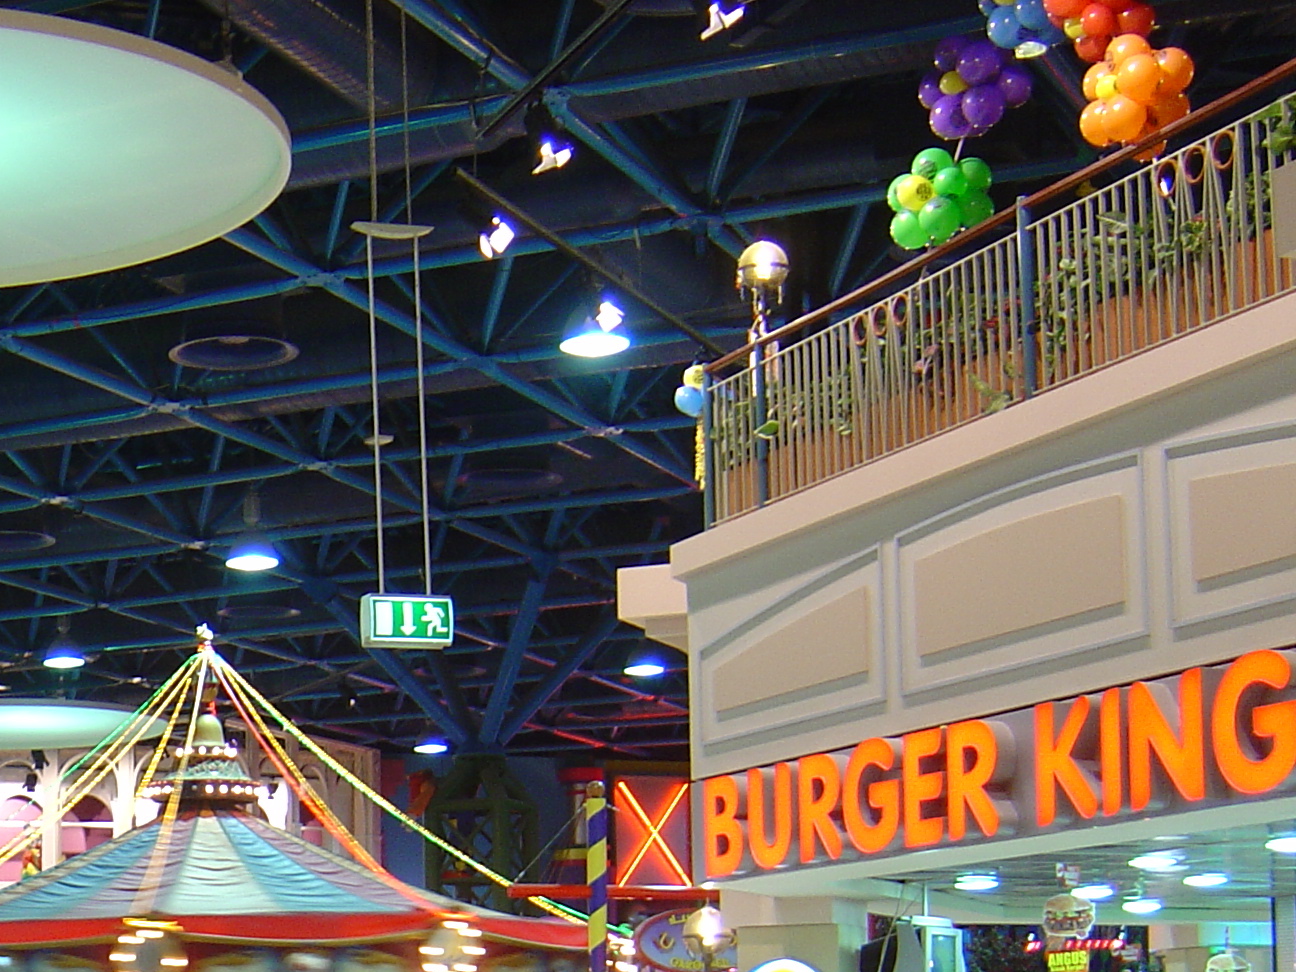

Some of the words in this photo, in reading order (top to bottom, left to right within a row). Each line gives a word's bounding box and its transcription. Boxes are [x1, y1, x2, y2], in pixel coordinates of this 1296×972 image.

[704, 719, 1000, 878] BURGER
[1034, 649, 1296, 827] KING
[1048, 951, 1087, 967] ANGUS
